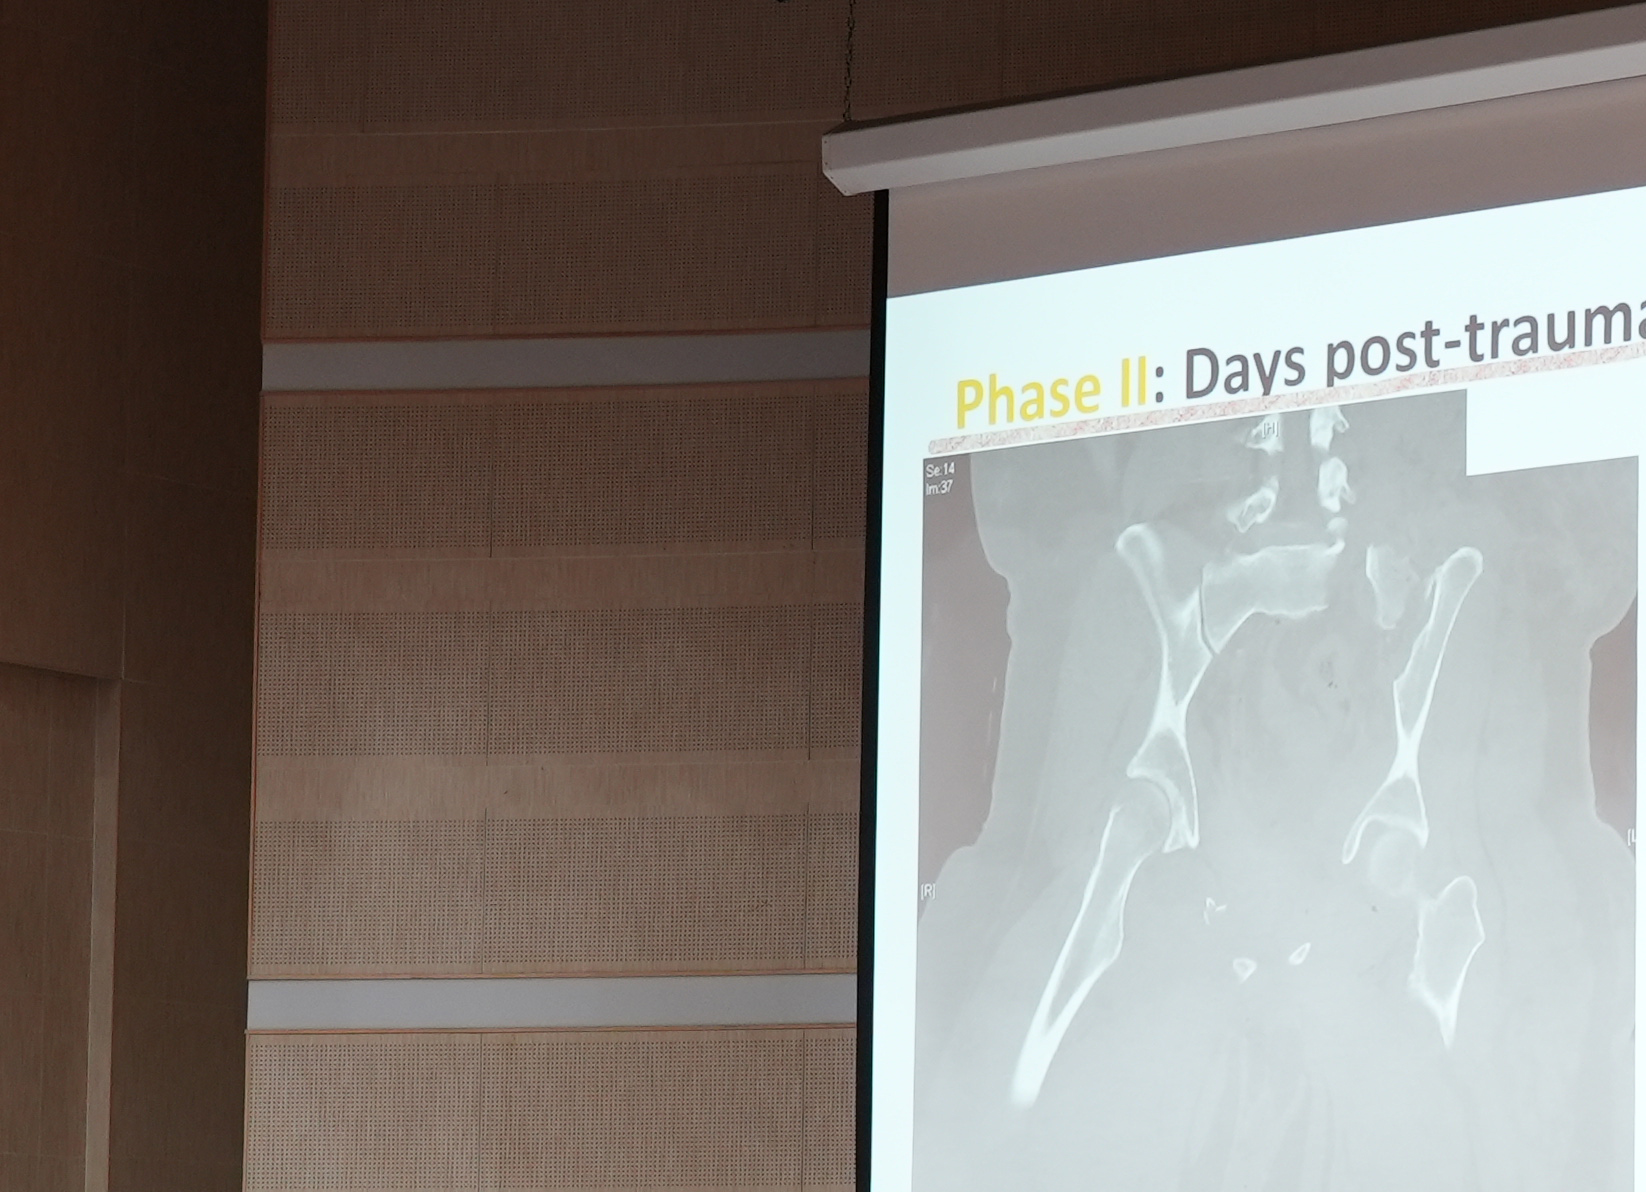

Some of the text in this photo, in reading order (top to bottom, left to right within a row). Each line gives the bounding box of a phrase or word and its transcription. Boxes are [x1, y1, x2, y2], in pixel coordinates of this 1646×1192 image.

[957, 373, 1102, 429] Phase
[1186, 347, 1306, 397] Days
[925, 461, 955, 478] Se:14
[925, 479, 954, 496] Im:37
